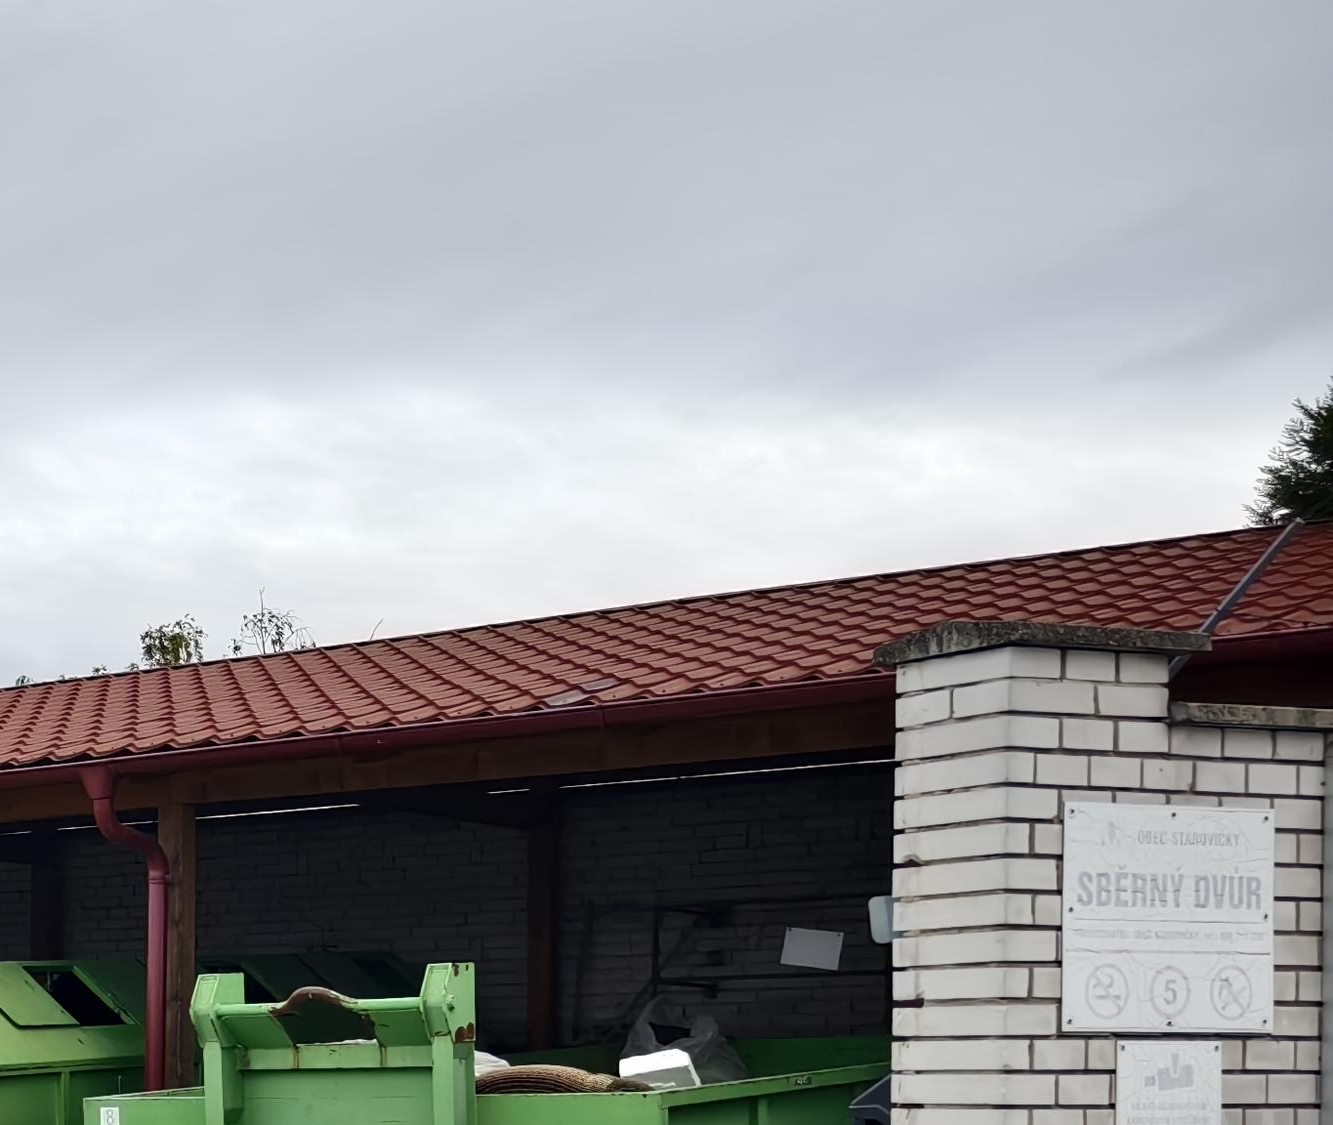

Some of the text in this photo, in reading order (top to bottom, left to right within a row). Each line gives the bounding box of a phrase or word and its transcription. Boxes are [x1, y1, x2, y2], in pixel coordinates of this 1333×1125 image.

[1076, 864, 1184, 909] SBĚRNÝ
[1162, 978, 1178, 1005] 5
[106, 1109, 114, 1125] 8
